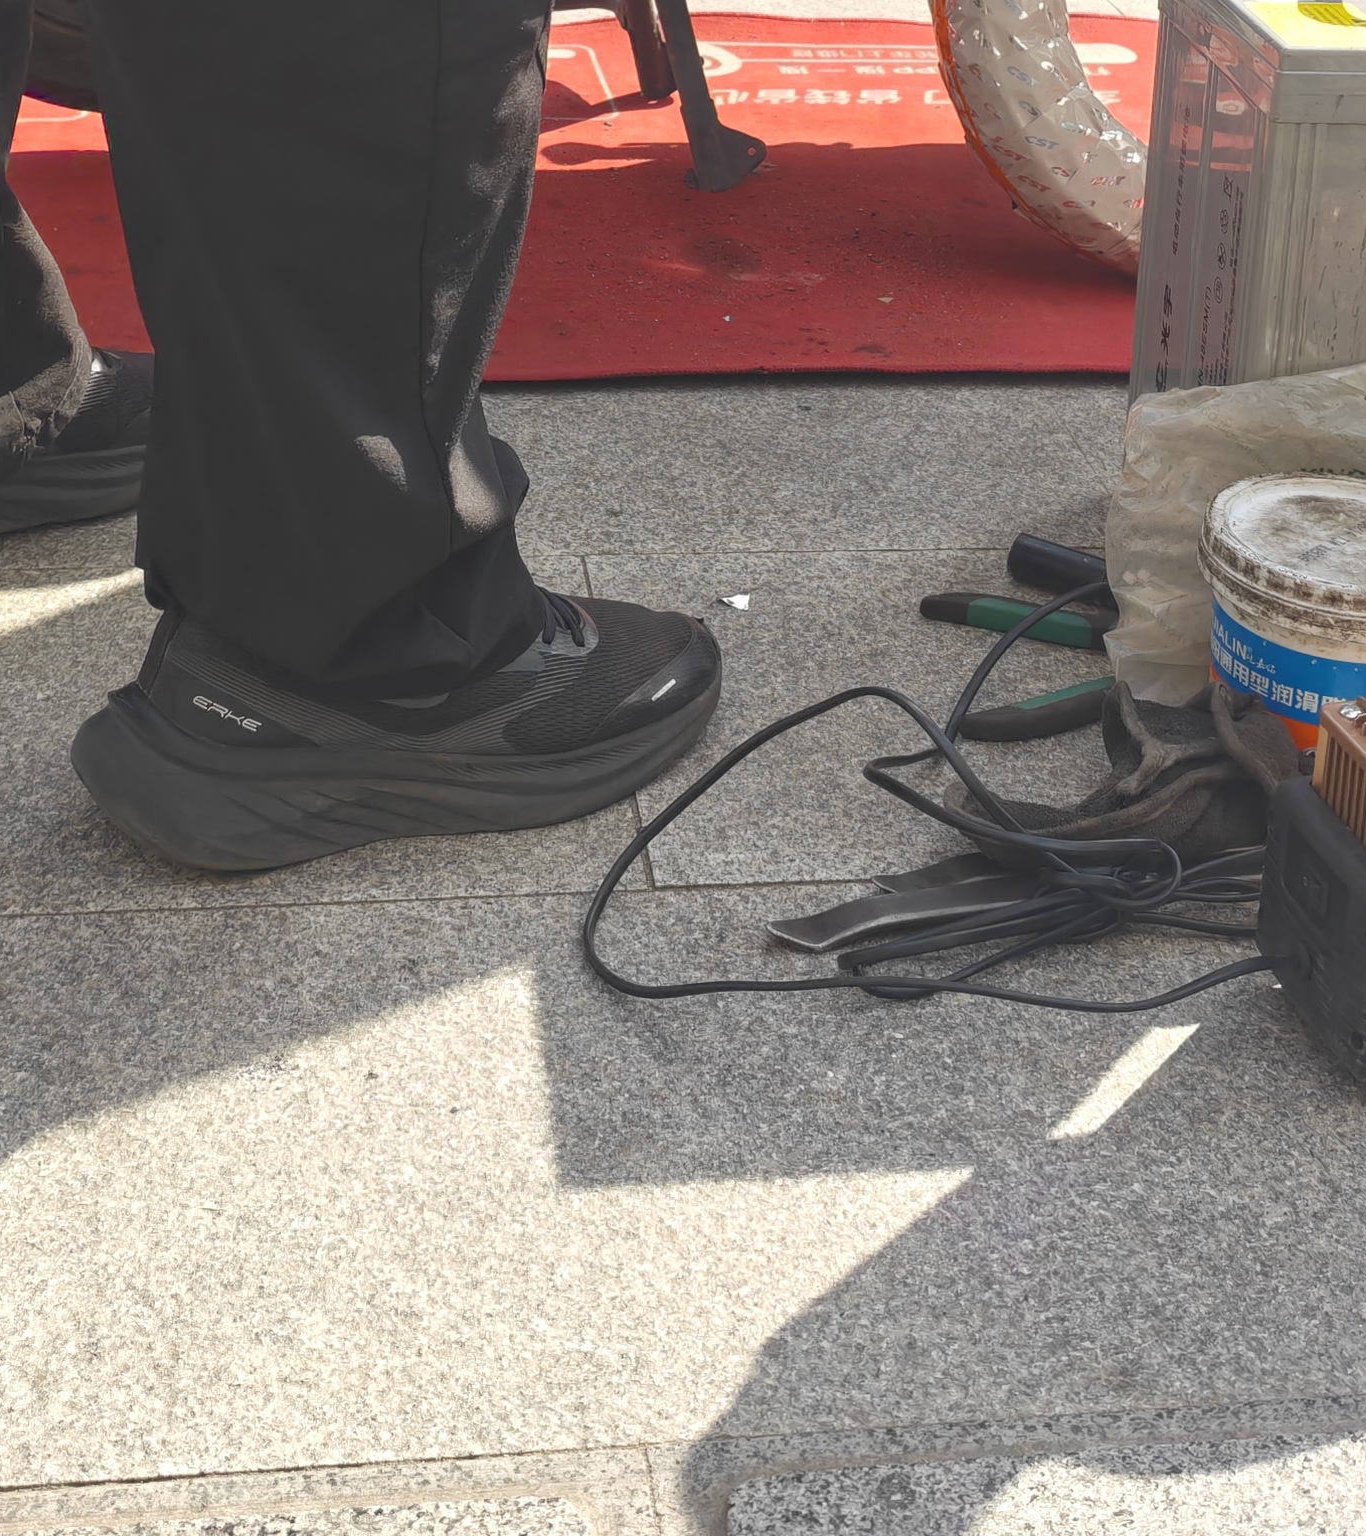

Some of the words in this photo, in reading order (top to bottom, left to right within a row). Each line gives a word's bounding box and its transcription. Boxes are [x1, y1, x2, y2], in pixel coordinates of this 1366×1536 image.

[1025, 135, 1060, 150] CST
[991, 144, 1027, 162] CST
[1018, 175, 1052, 193] CST
[192, 695, 263, 732] ERKE
